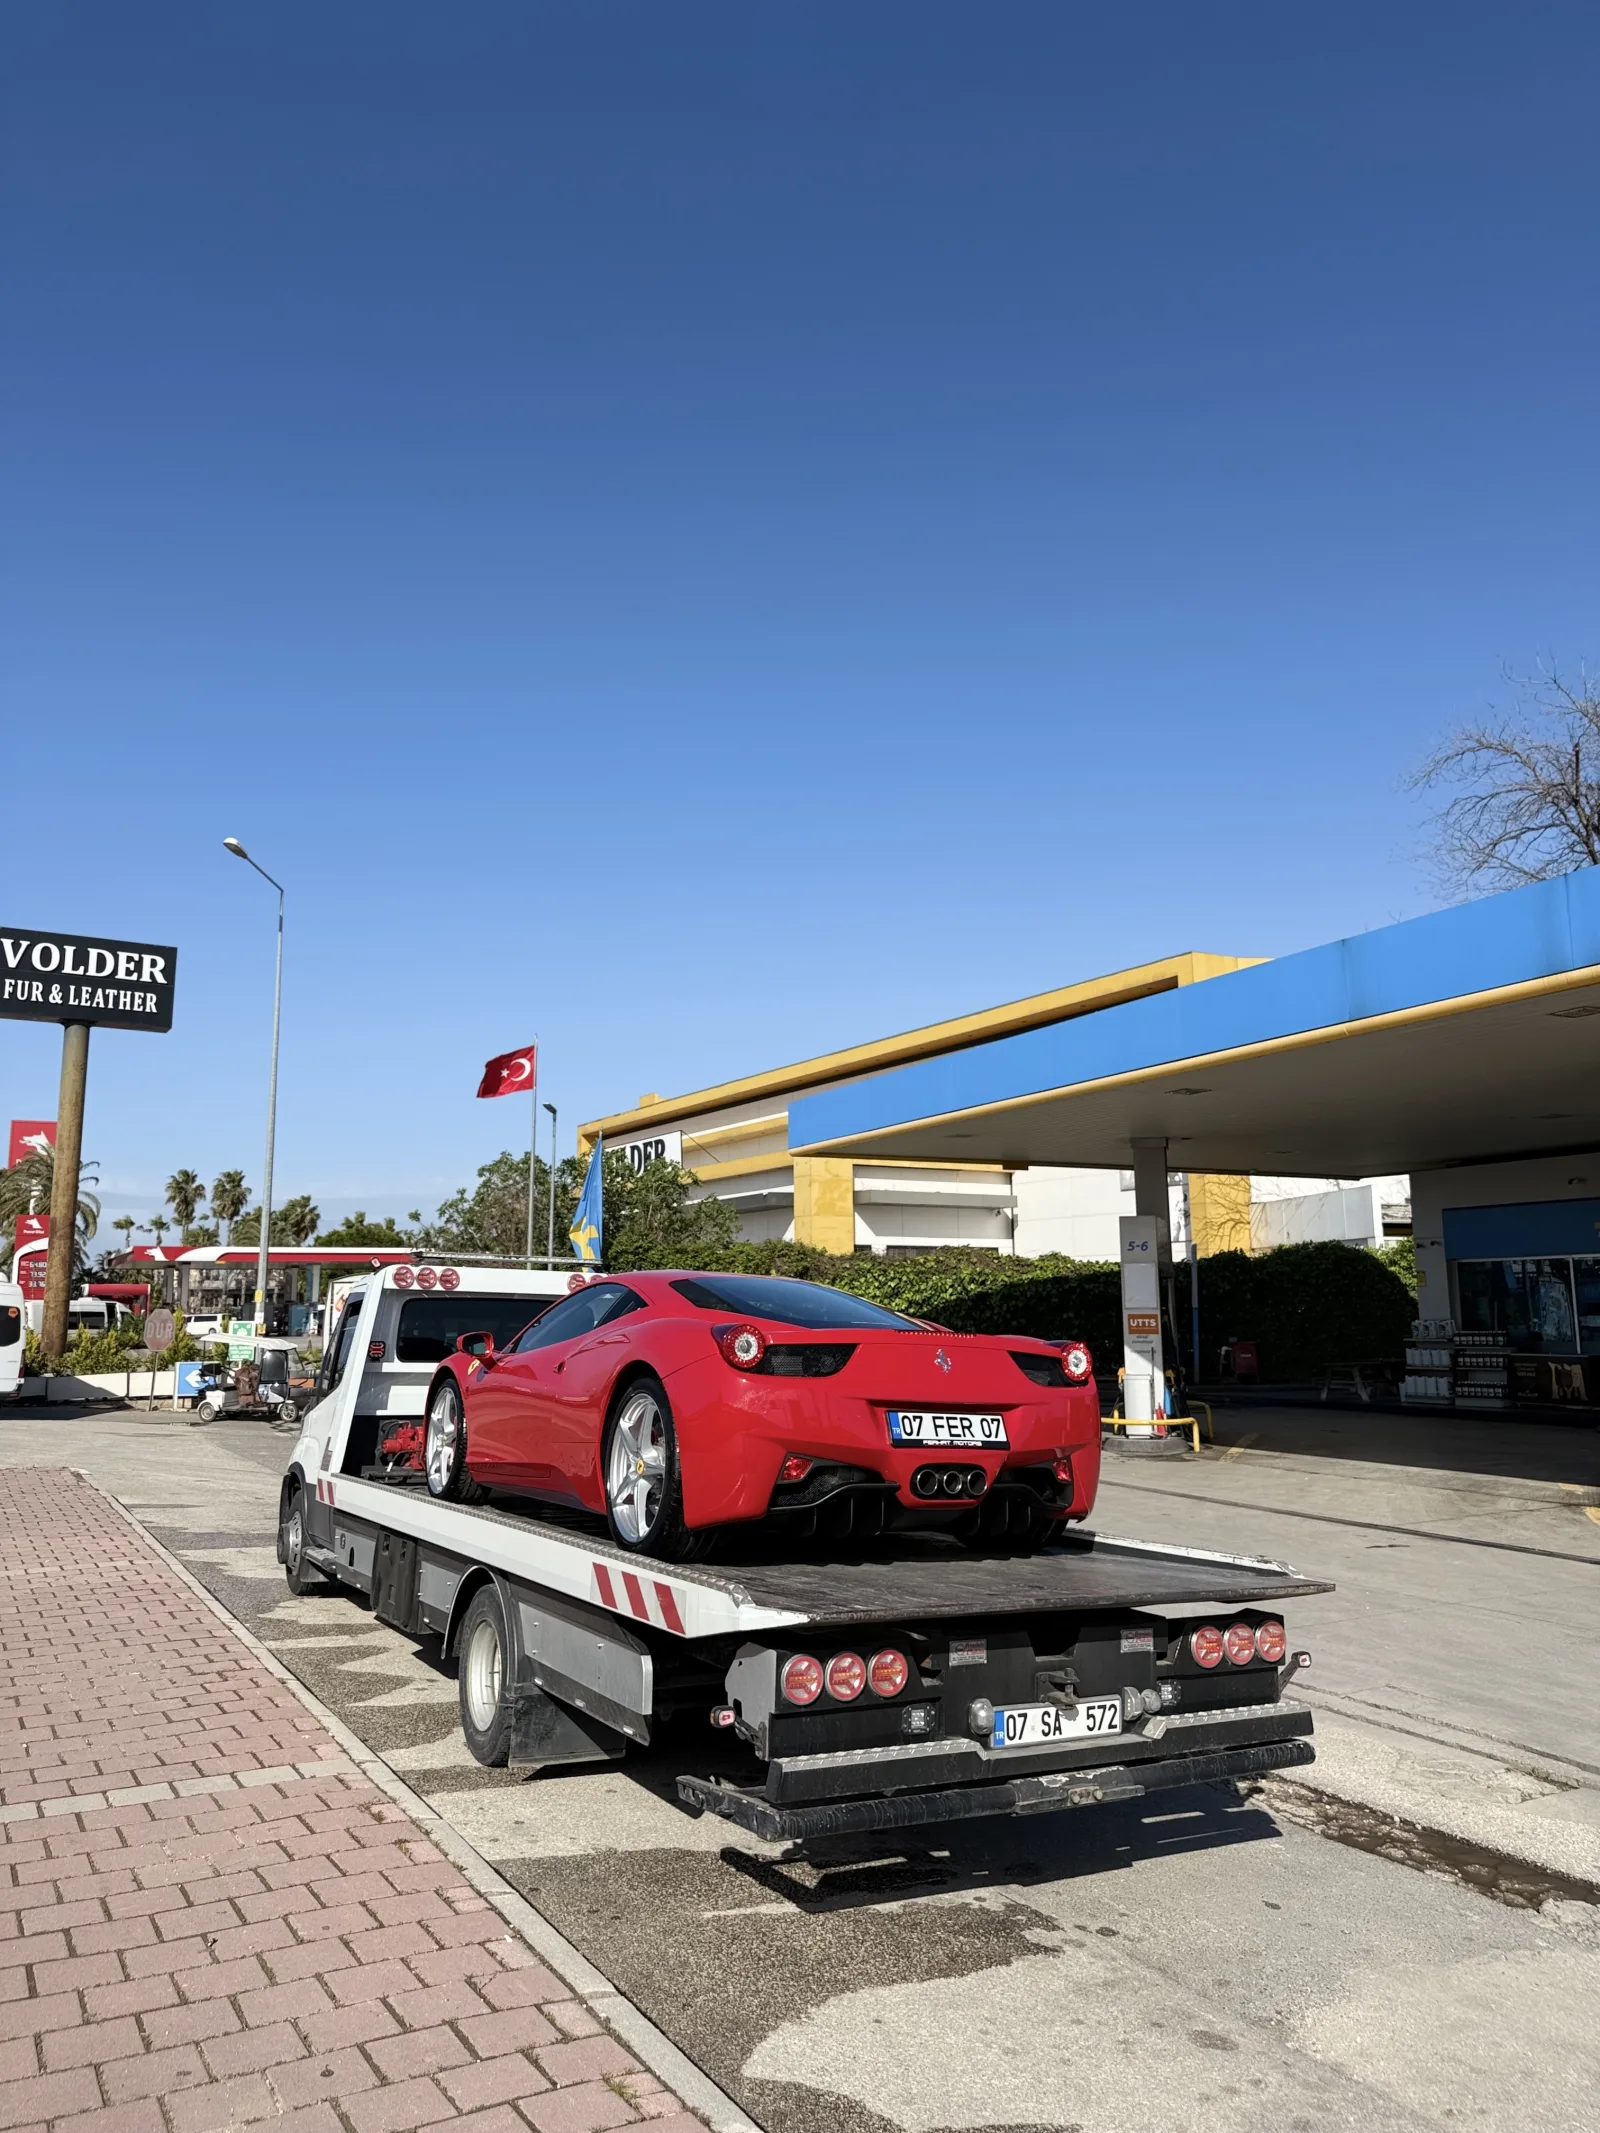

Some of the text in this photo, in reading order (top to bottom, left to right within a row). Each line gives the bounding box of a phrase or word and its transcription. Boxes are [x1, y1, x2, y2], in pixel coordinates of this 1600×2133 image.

[0, 938, 168, 984] VOLDER
[3, 979, 158, 1013] FUR & LEATHER
[1127, 1241, 1148, 1252] 5-6
[146, 1322, 173, 1338] DUR
[1130, 1318, 1157, 1327] UTTS
[901, 1415, 923, 1437] 07
[932, 1416, 975, 1438] FER
[980, 1418, 1001, 1439] 07
[995, 1703, 1118, 1741] TR 07 SA 572
